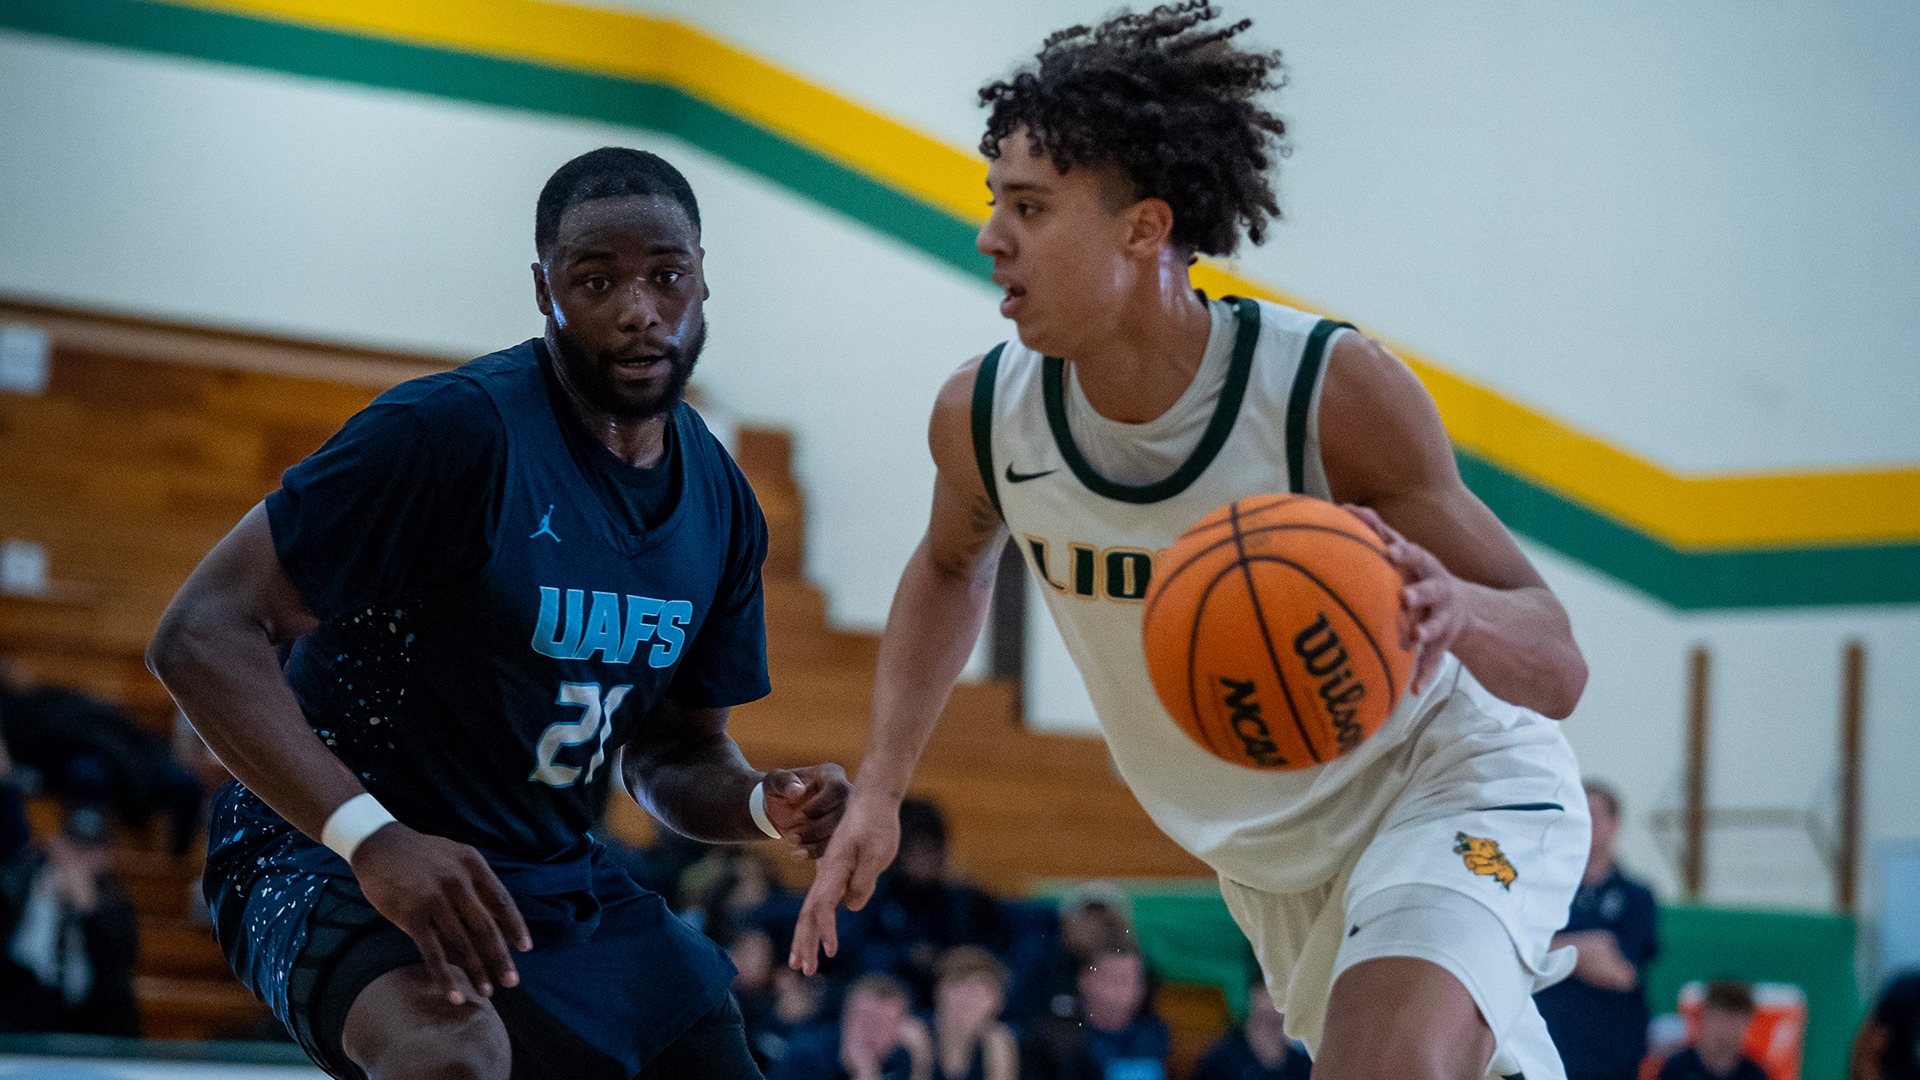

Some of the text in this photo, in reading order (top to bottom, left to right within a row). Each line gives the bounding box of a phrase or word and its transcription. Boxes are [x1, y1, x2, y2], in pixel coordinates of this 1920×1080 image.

[1025, 534, 1163, 604] LIO
[531, 586, 693, 668] UAFS
[1294, 611, 1364, 754] Wilso
[528, 681, 634, 788] 21
